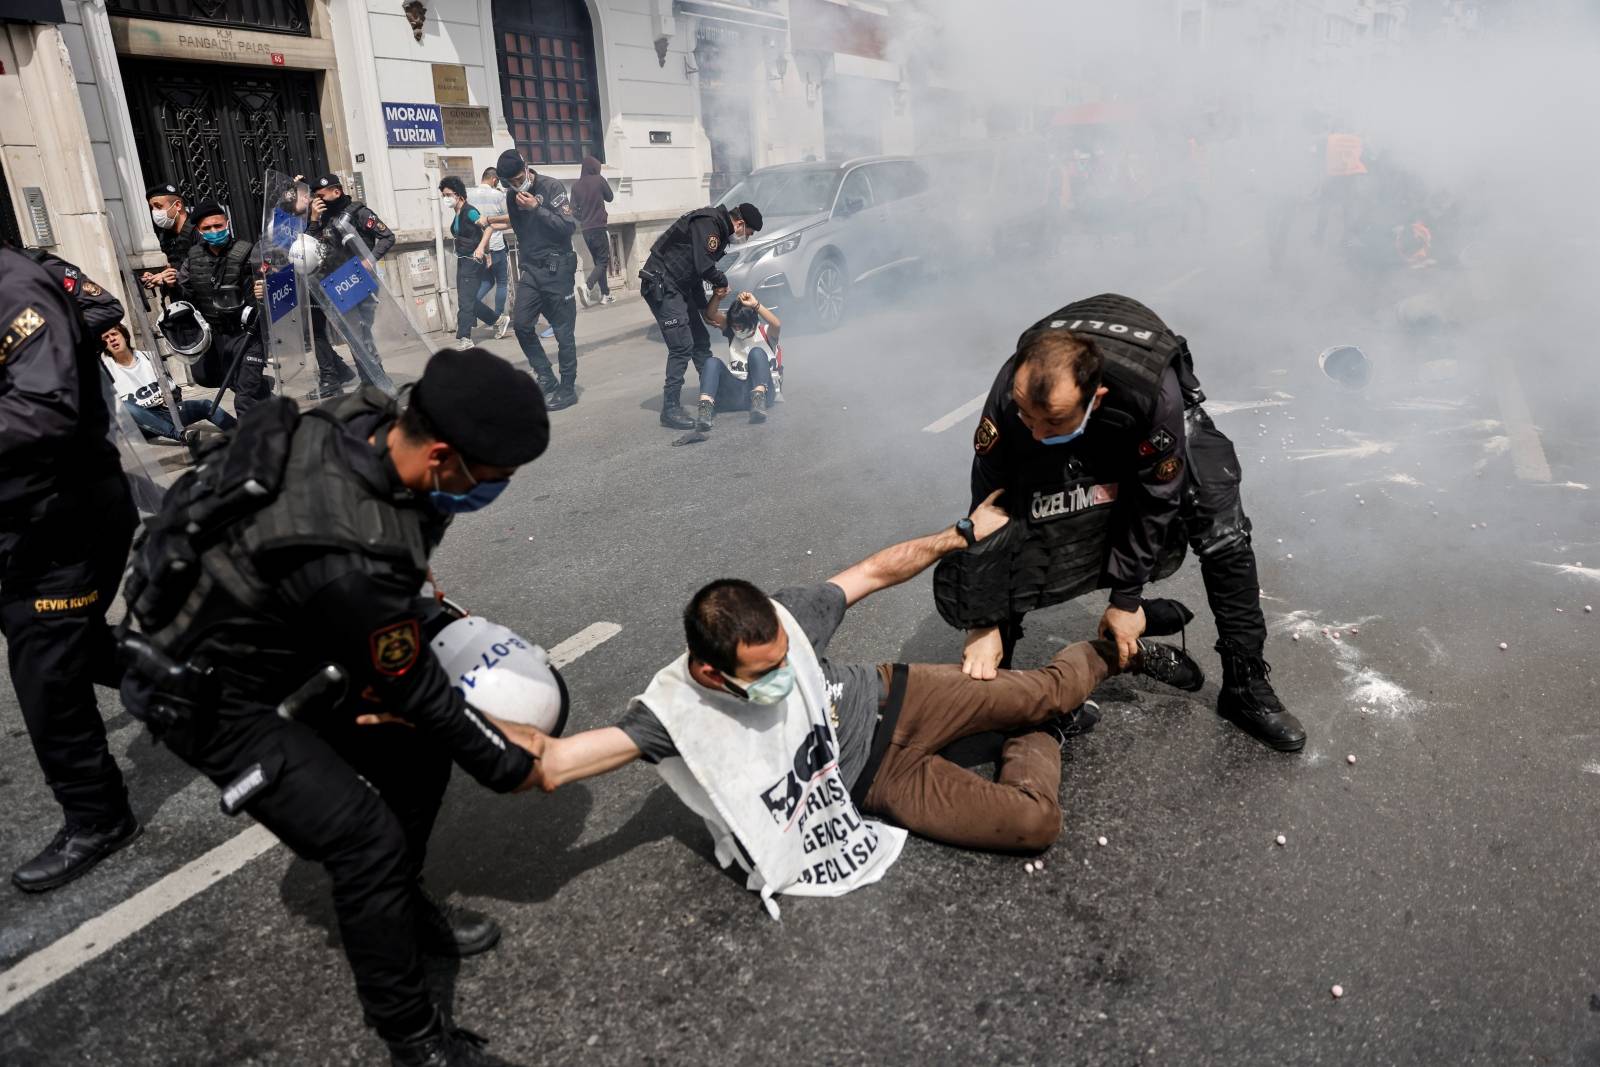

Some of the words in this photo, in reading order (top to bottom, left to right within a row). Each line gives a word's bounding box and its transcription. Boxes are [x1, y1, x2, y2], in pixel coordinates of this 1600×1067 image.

[238, 41, 271, 54] PALAS
[385, 107, 439, 122] MORAVA
[393, 125, 437, 142] TURİZM
[1031, 491, 1069, 519] ÖZEL
[1069, 484, 1095, 512] TİM
